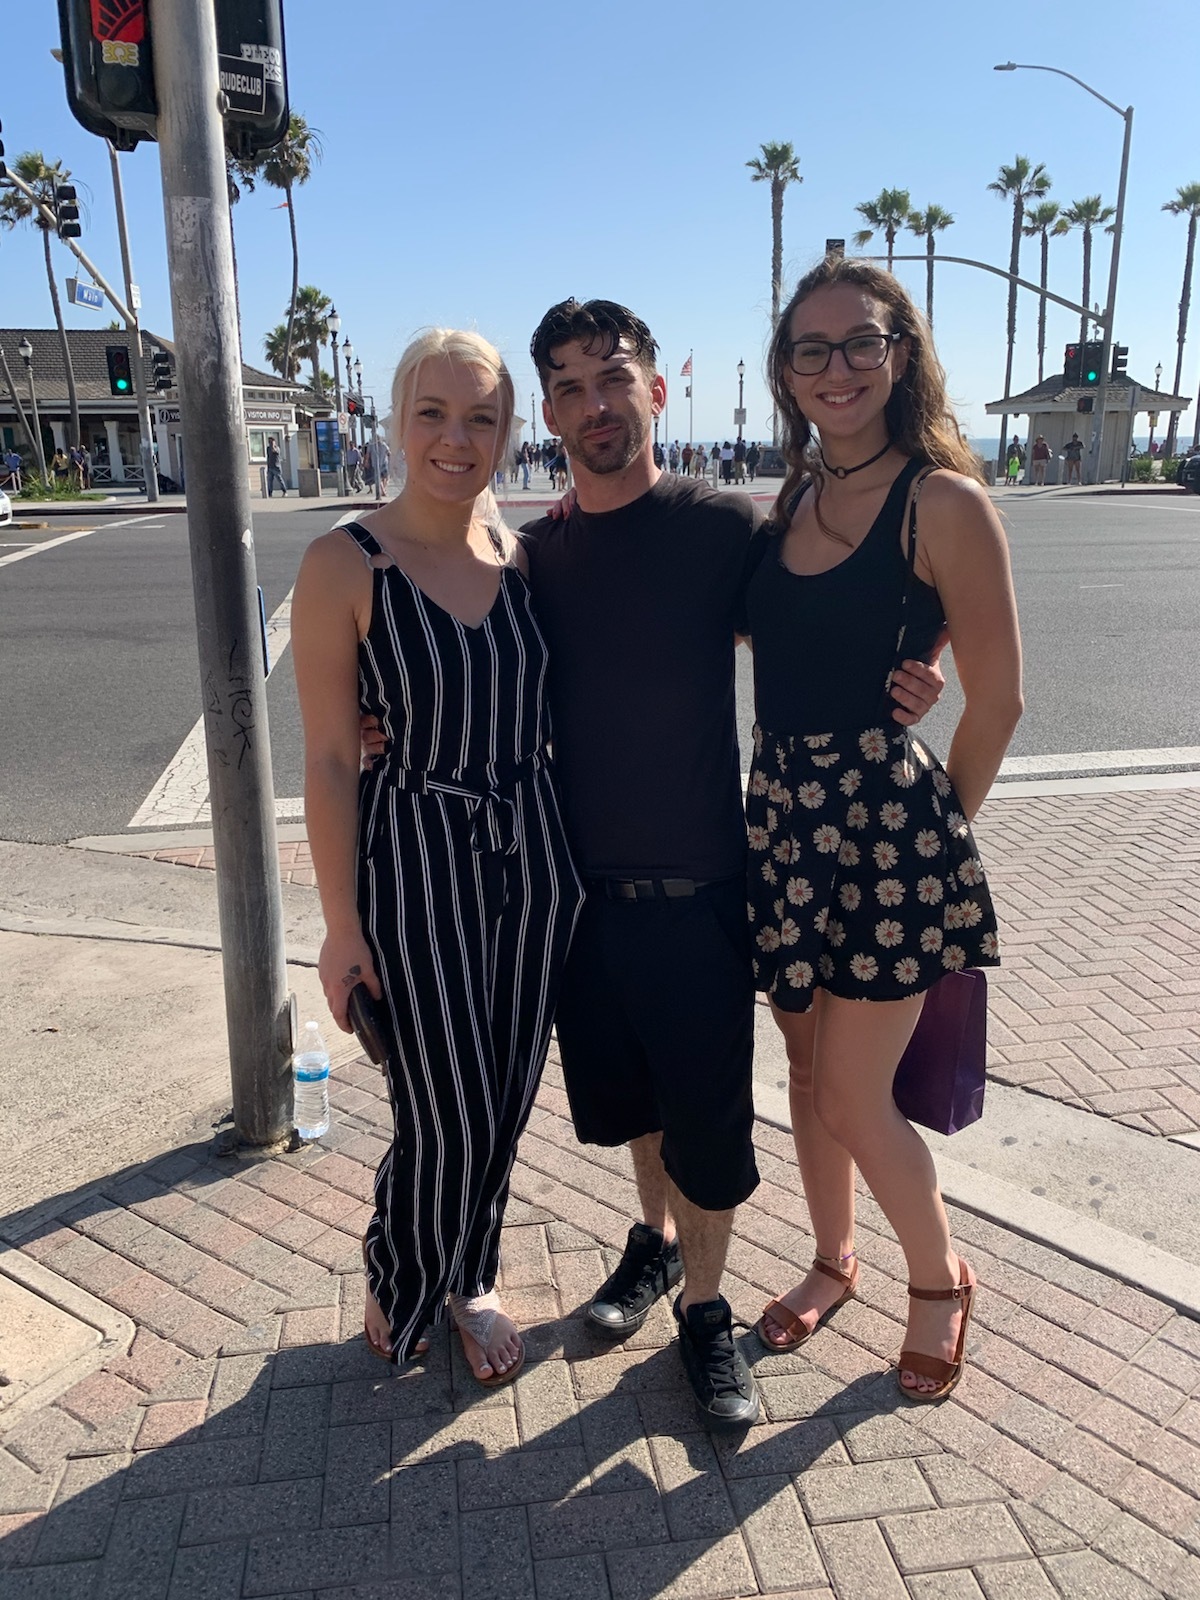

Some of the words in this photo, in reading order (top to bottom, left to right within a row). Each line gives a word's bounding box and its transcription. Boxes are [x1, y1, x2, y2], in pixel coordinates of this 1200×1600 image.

[83, 289, 98, 303] Main
[247, 411, 266, 419] VISITOR
[268, 411, 280, 419] INFO
